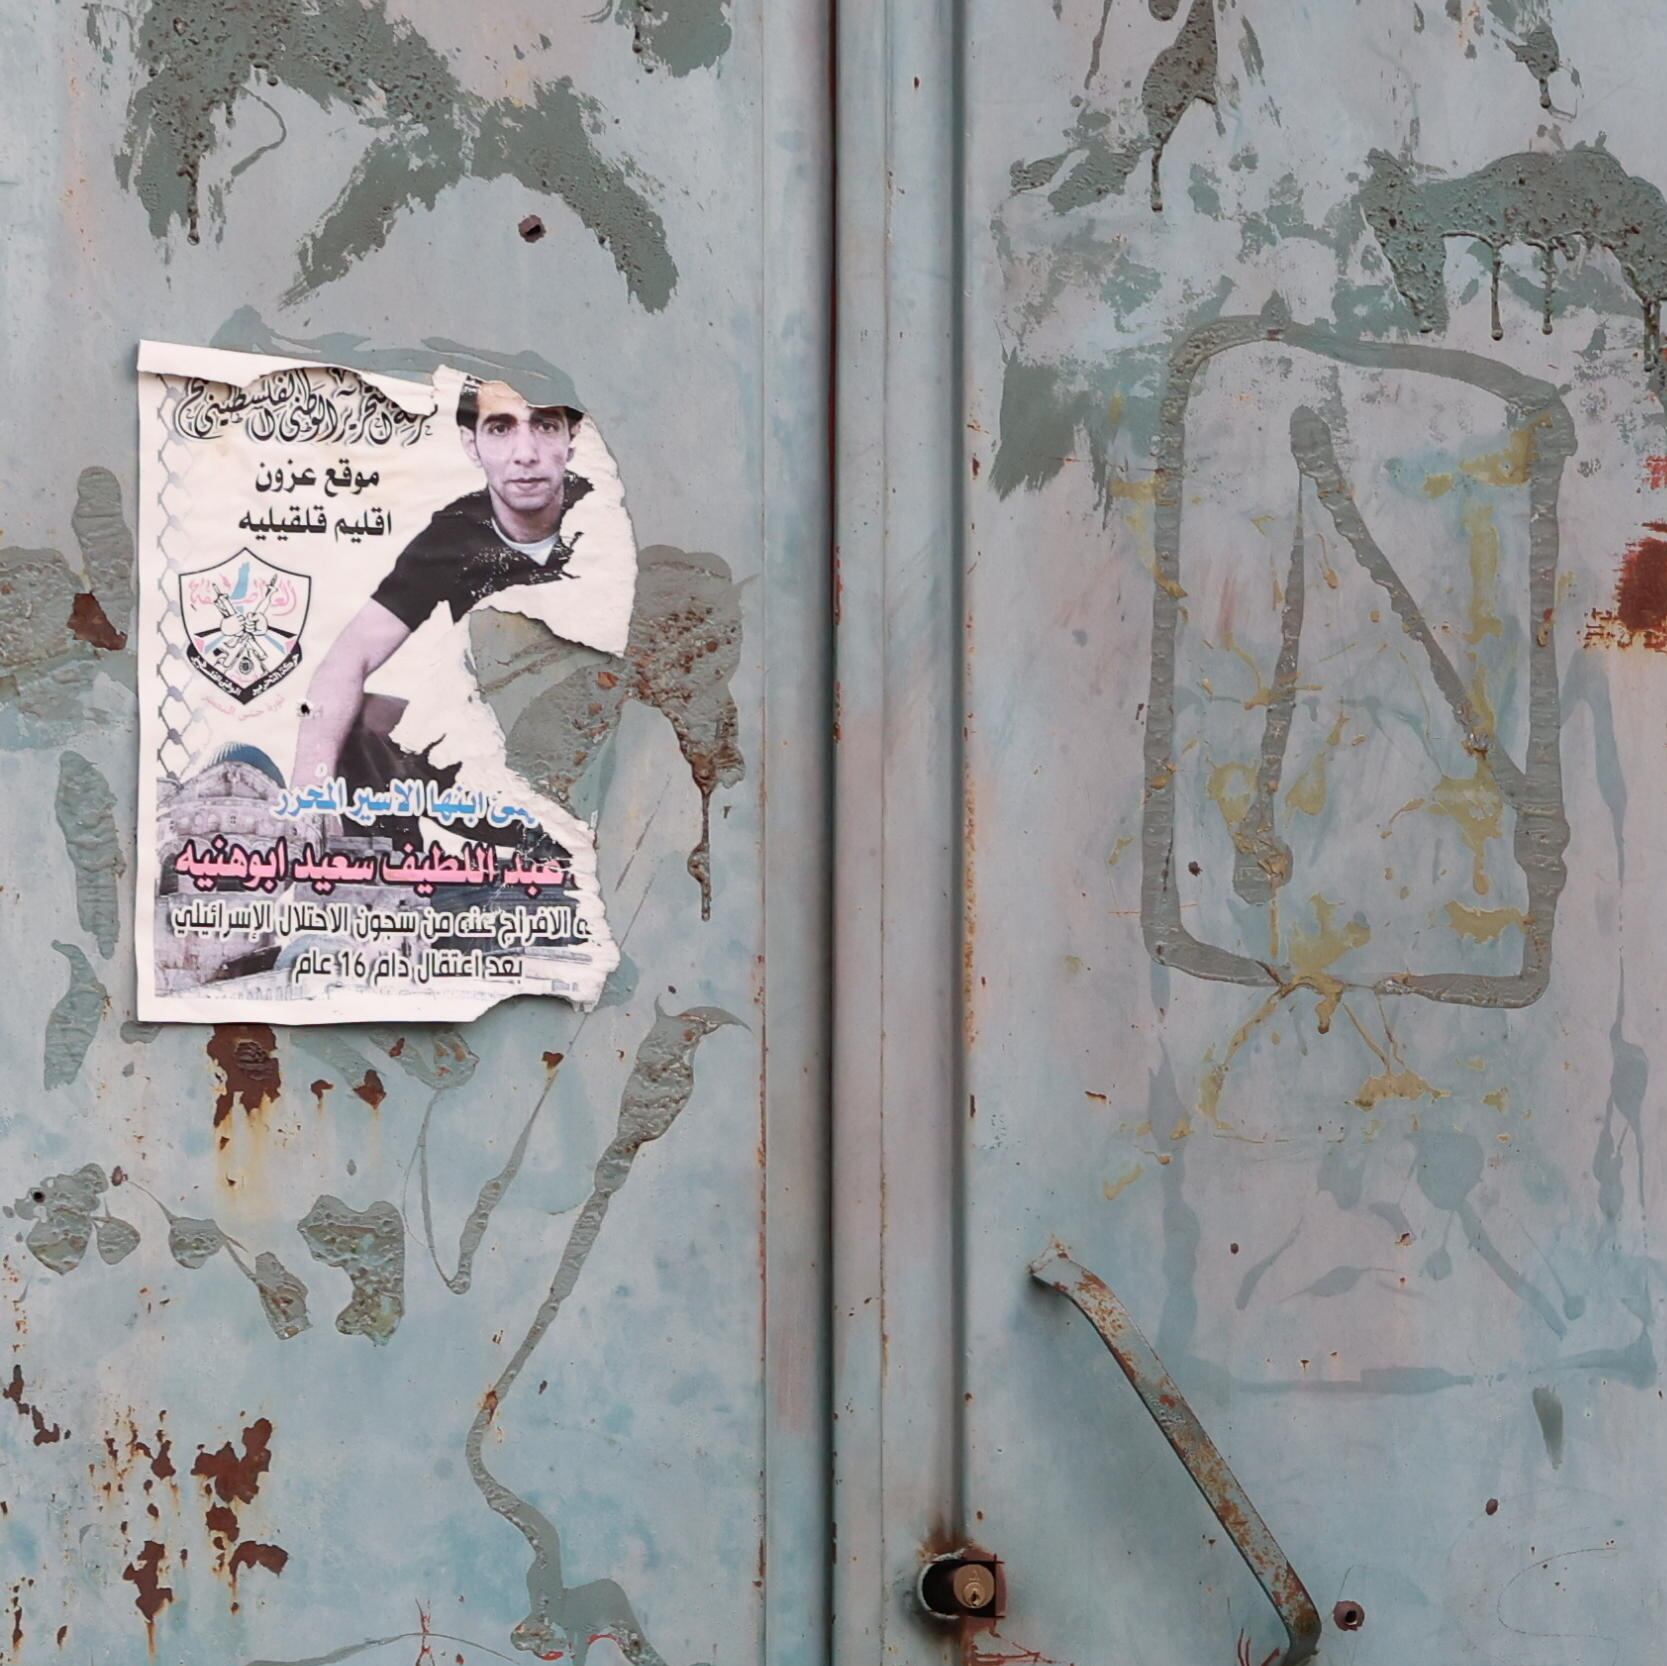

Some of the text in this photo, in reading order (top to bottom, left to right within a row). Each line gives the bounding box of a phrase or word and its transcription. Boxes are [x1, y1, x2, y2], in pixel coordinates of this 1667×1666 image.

[256, 459, 379, 497] موقع عزون
[238, 504, 392, 543] اقليم قلقيليه
[350, 780, 423, 820] الاسير
[428, 782, 484, 822] ابنها
[293, 842, 376, 894] سعيد
[381, 841, 495, 895] اللطيف
[503, 854, 565, 895] عبد
[175, 903, 272, 939] الإسرائيلي
[279, 904, 348, 936] الاحتلال
[355, 906, 416, 940] سجون
[423, 908, 450, 940] من
[457, 908, 496, 936] عنه
[500, 907, 569, 946] الافراج
[296, 949, 523, 986] بعد اعتقال دام 16 عام
